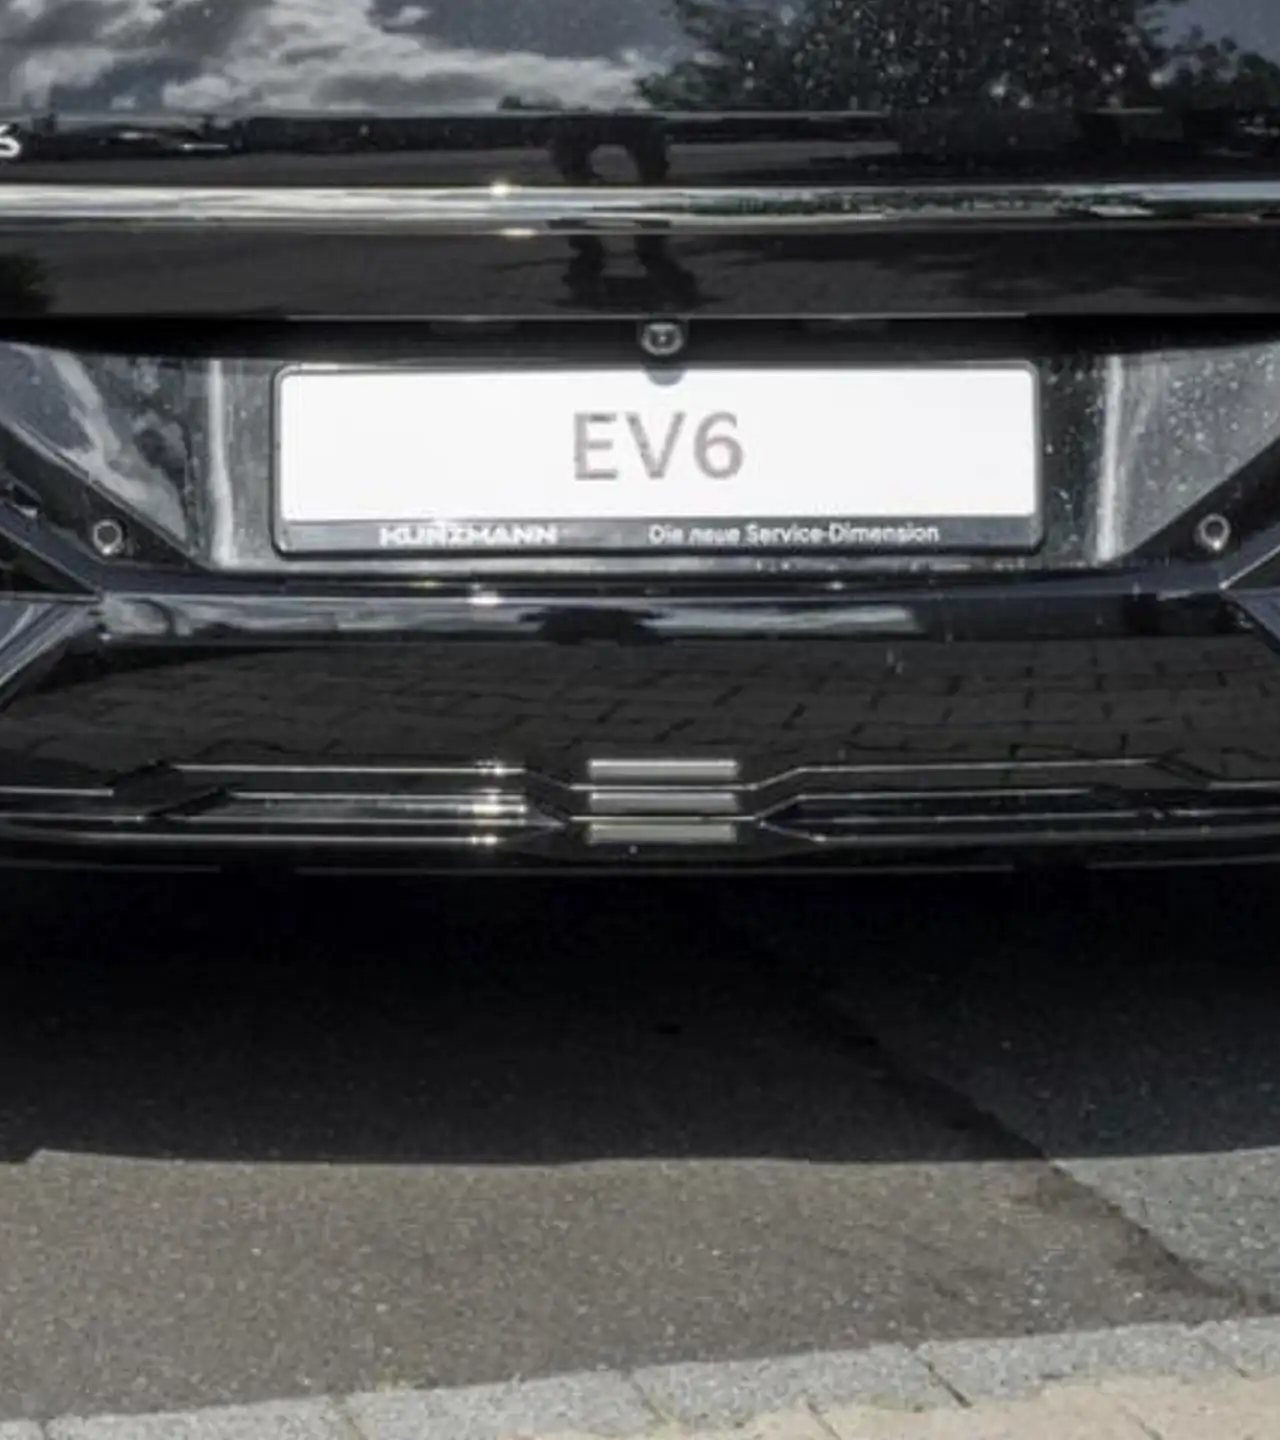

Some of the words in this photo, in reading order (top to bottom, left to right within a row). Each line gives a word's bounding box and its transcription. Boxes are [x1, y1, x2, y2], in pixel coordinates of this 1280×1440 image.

[574, 411, 745, 480] EV6
[379, 524, 558, 546] KUNZMANN
[648, 523, 683, 545] Die
[689, 526, 740, 544] neue
[745, 521, 939, 545] Service-Dimension
